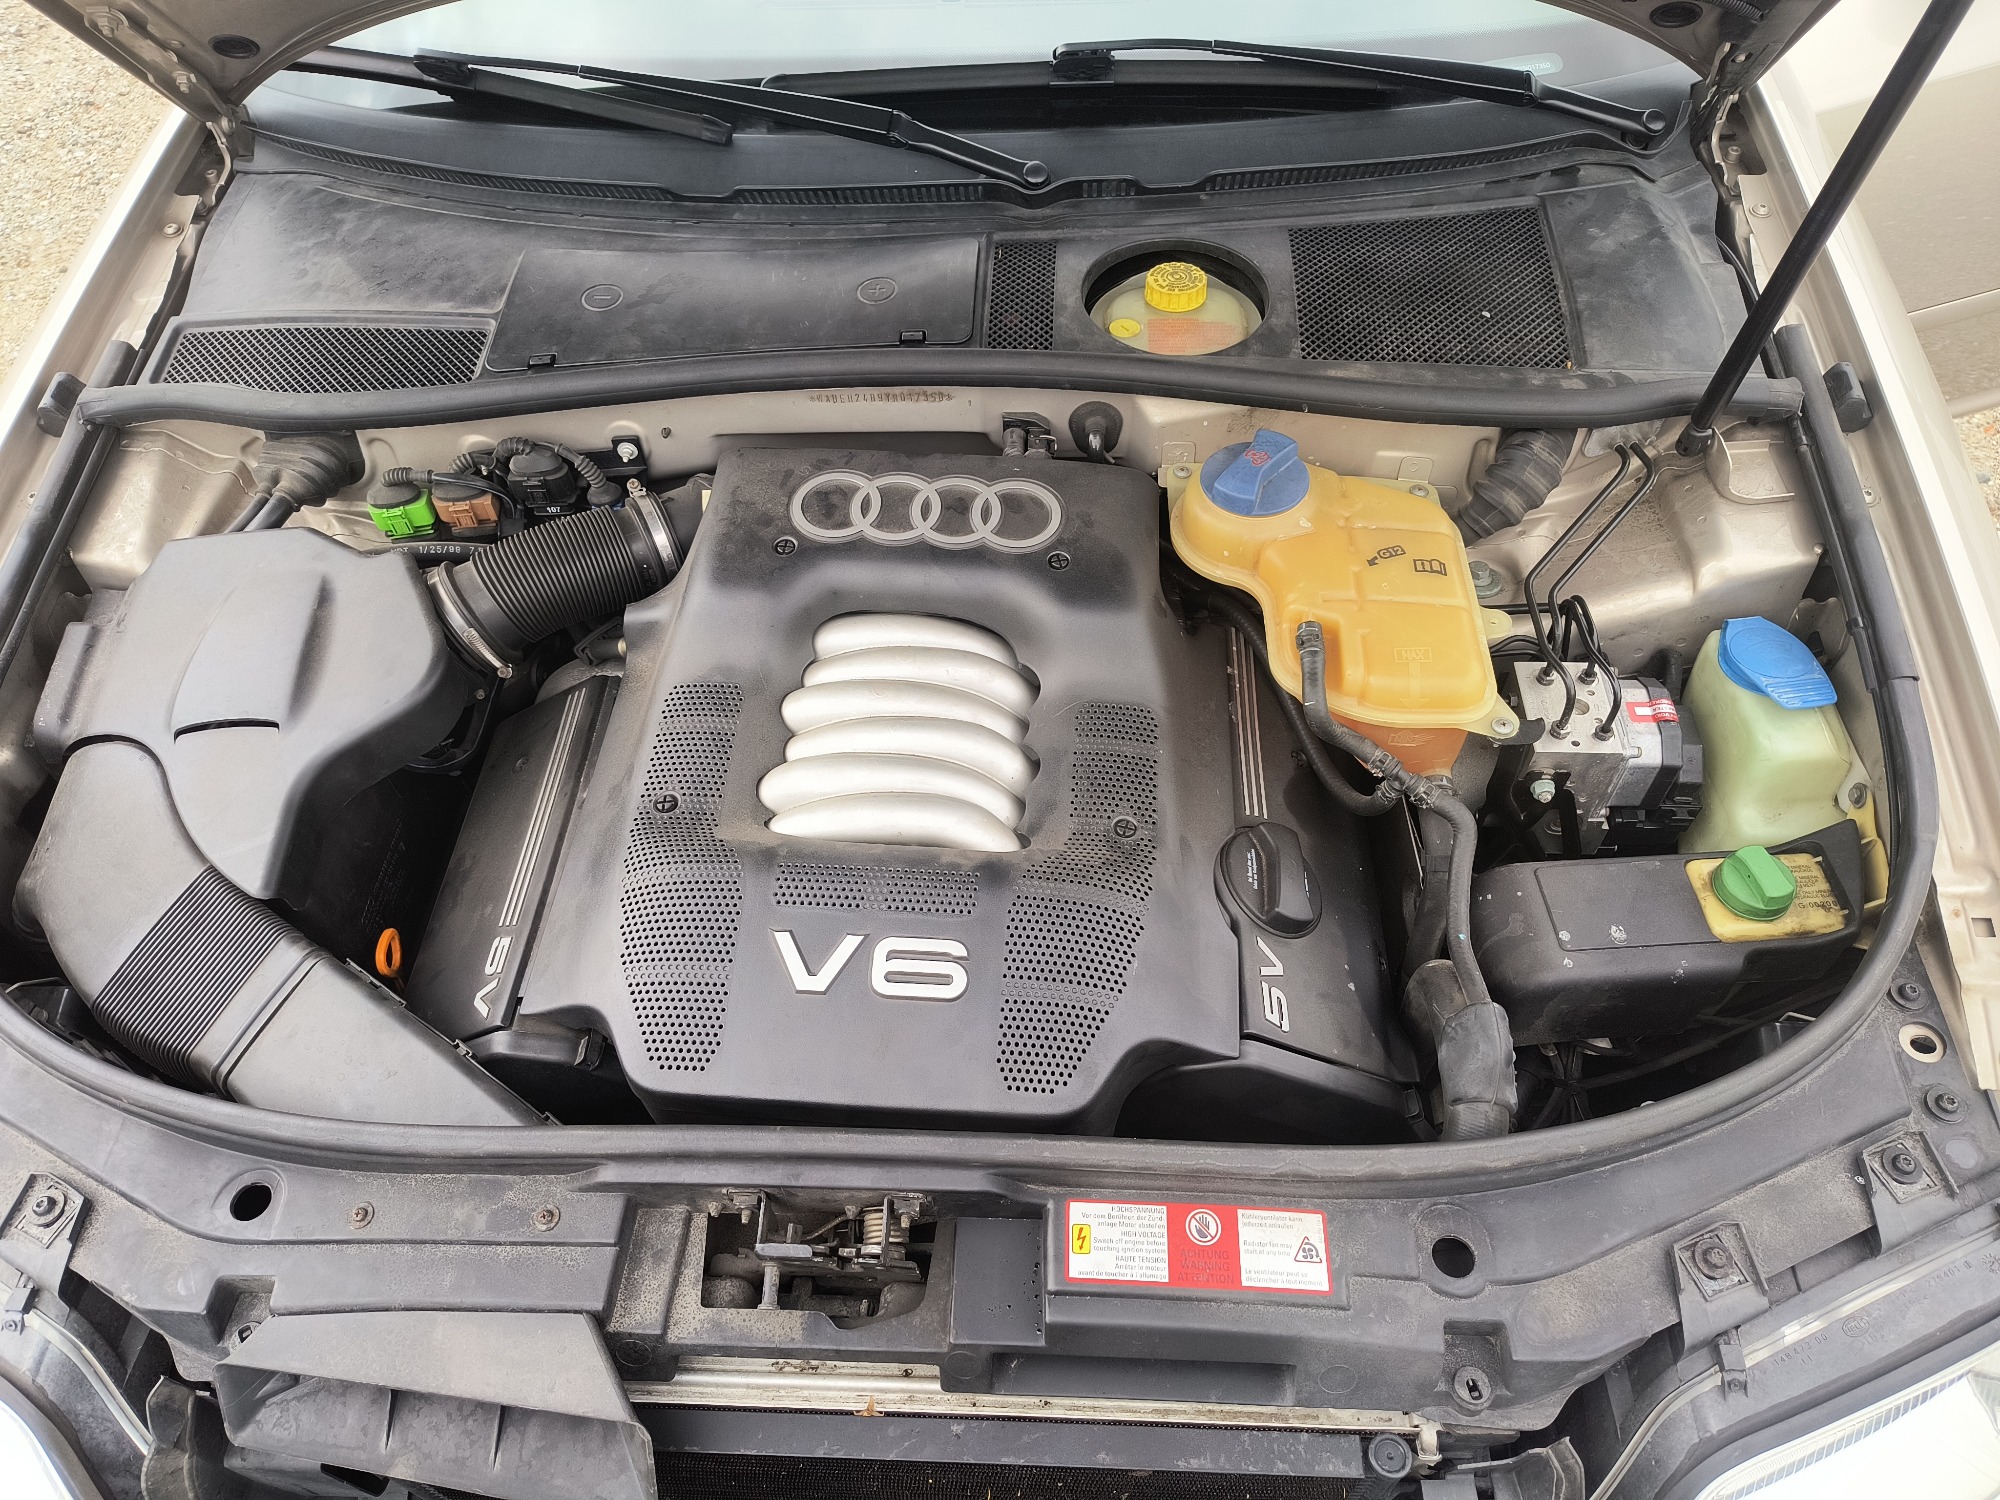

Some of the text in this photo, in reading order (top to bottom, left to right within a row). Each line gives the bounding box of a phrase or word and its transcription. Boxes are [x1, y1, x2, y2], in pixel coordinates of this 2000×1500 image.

[1379, 546, 1404, 558] G12
[771, 929, 969, 1001] V6
[474, 936, 513, 1020] 5V
[1256, 935, 1289, 1033] 5V
[1138, 1231, 1166, 1239] VOLTAGE
[1125, 1238, 1145, 1247] engine
[1146, 1239, 1166, 1247] before
[1094, 1245, 1120, 1253] touching
[1121, 1246, 1144, 1254] ignition
[1181, 1249, 1229, 1260] ACHTUNG
[1138, 1256, 1167, 1264] TENSION
[1181, 1260, 1230, 1271] WARNING
[1178, 1272, 1234, 1284] ATTENTION
